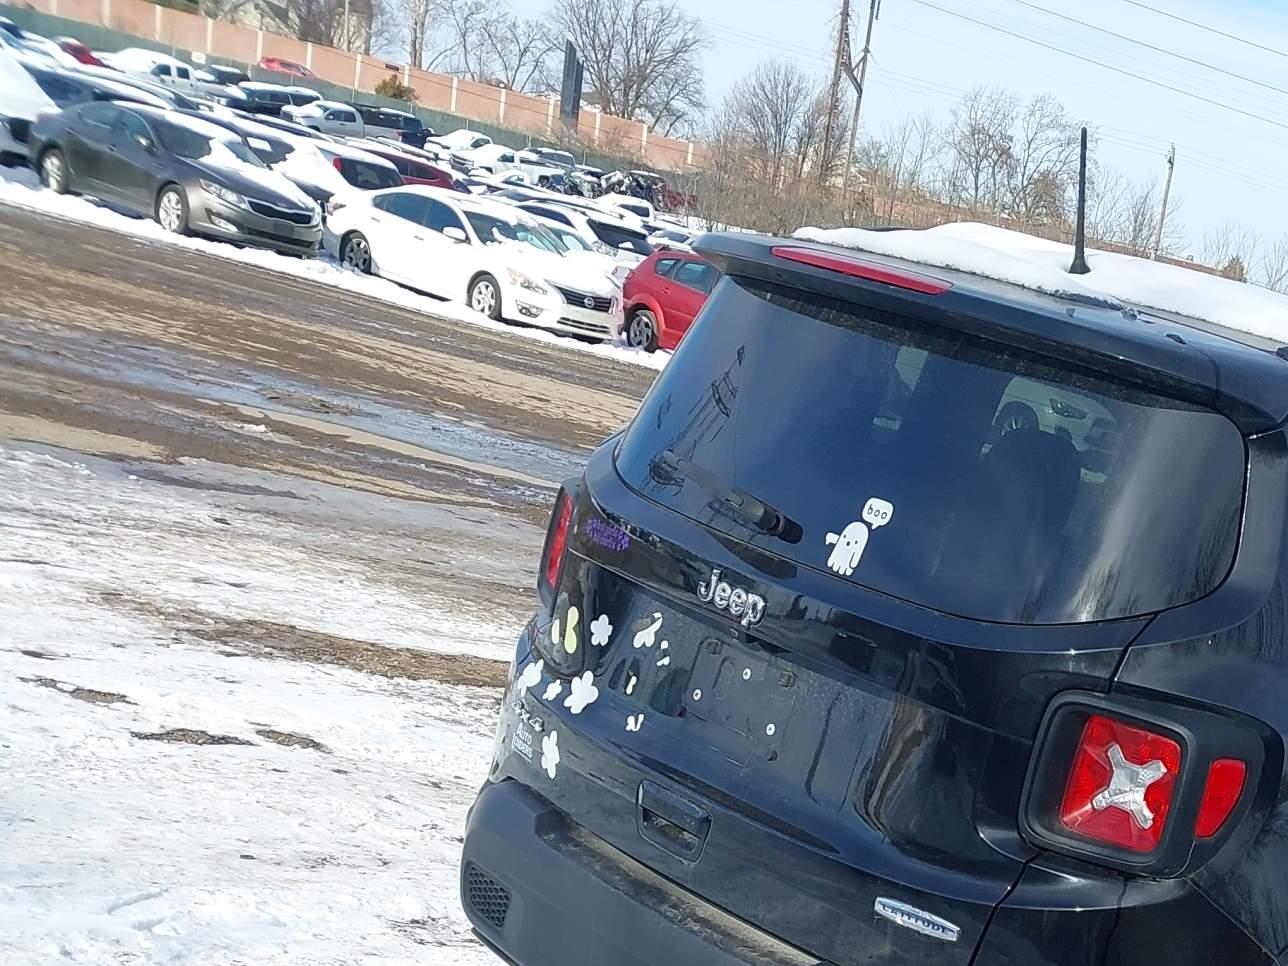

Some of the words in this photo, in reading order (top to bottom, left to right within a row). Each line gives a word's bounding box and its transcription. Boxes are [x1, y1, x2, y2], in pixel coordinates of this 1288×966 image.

[867, 503, 888, 520] boo
[697, 568, 766, 627] Jeep
[516, 723, 533, 745] AUTO
[879, 902, 950, 936] LATITUDE
